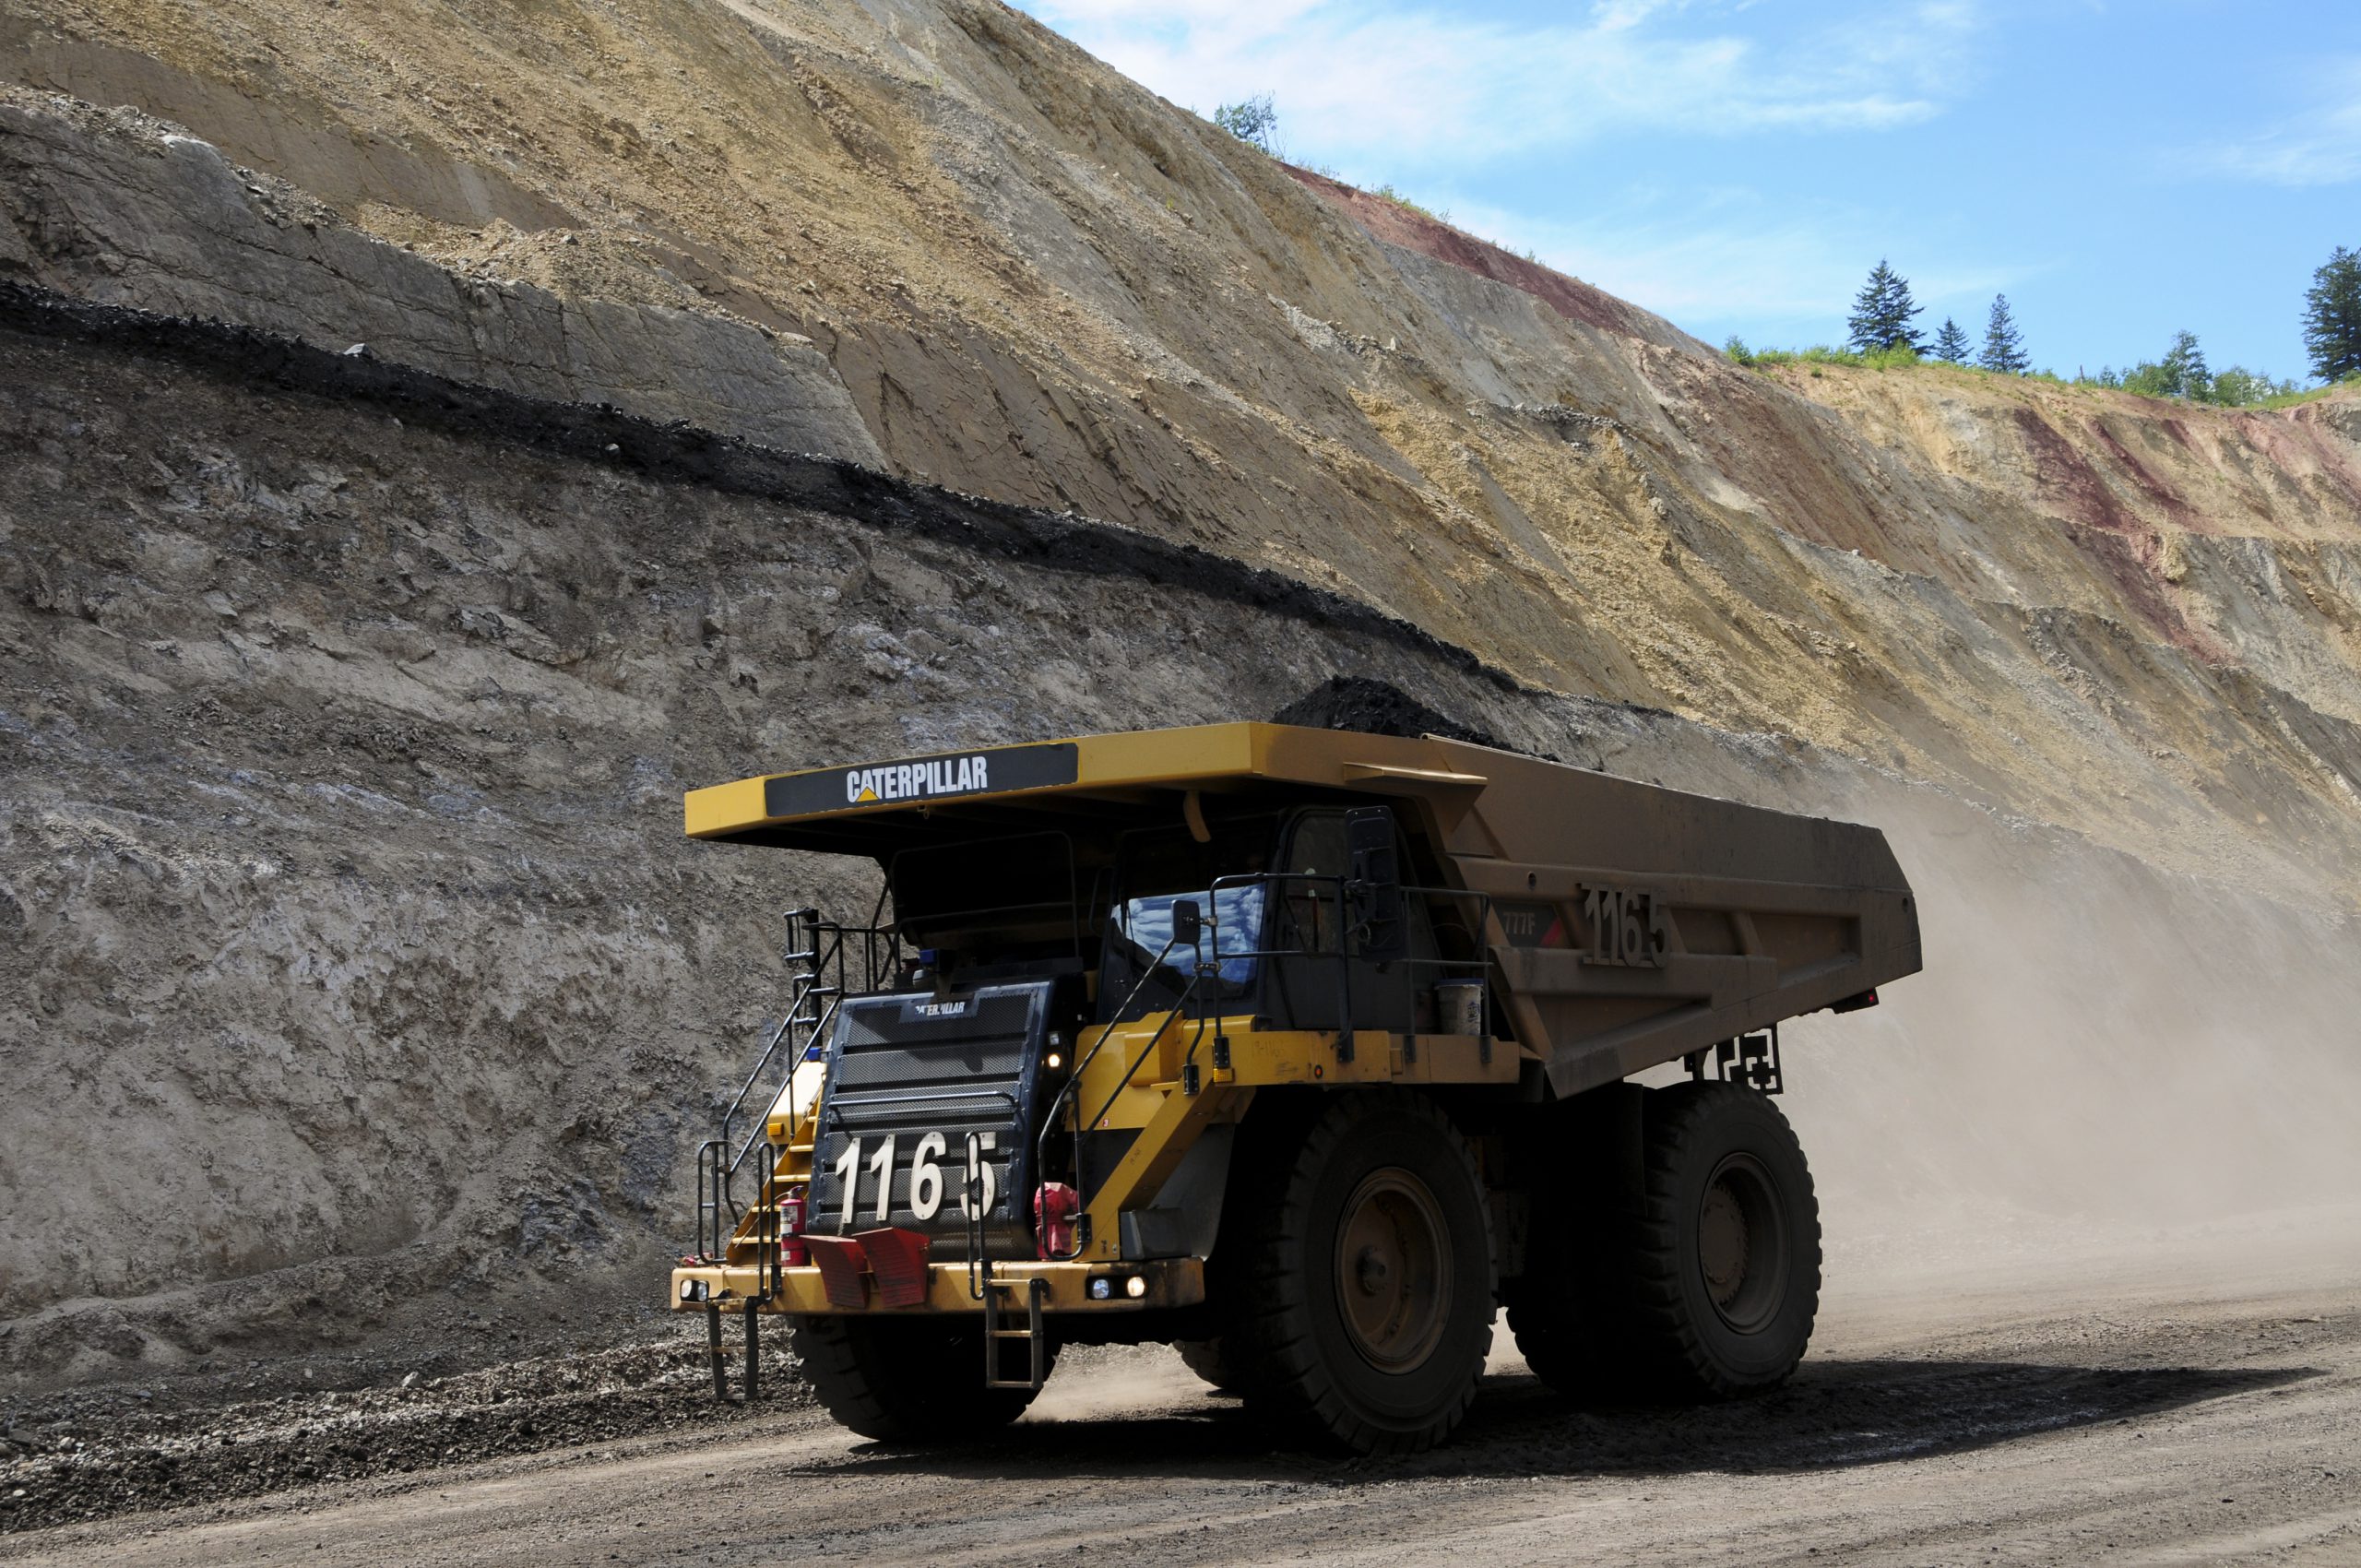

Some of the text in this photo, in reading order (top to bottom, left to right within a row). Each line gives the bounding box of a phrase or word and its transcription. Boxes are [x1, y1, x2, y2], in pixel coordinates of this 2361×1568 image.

[847, 756, 988, 803] CATERPILLAR
[1502, 911, 1536, 935] 777F
[1584, 885, 1670, 968] 1165
[835, 1131, 997, 1224] 1165
